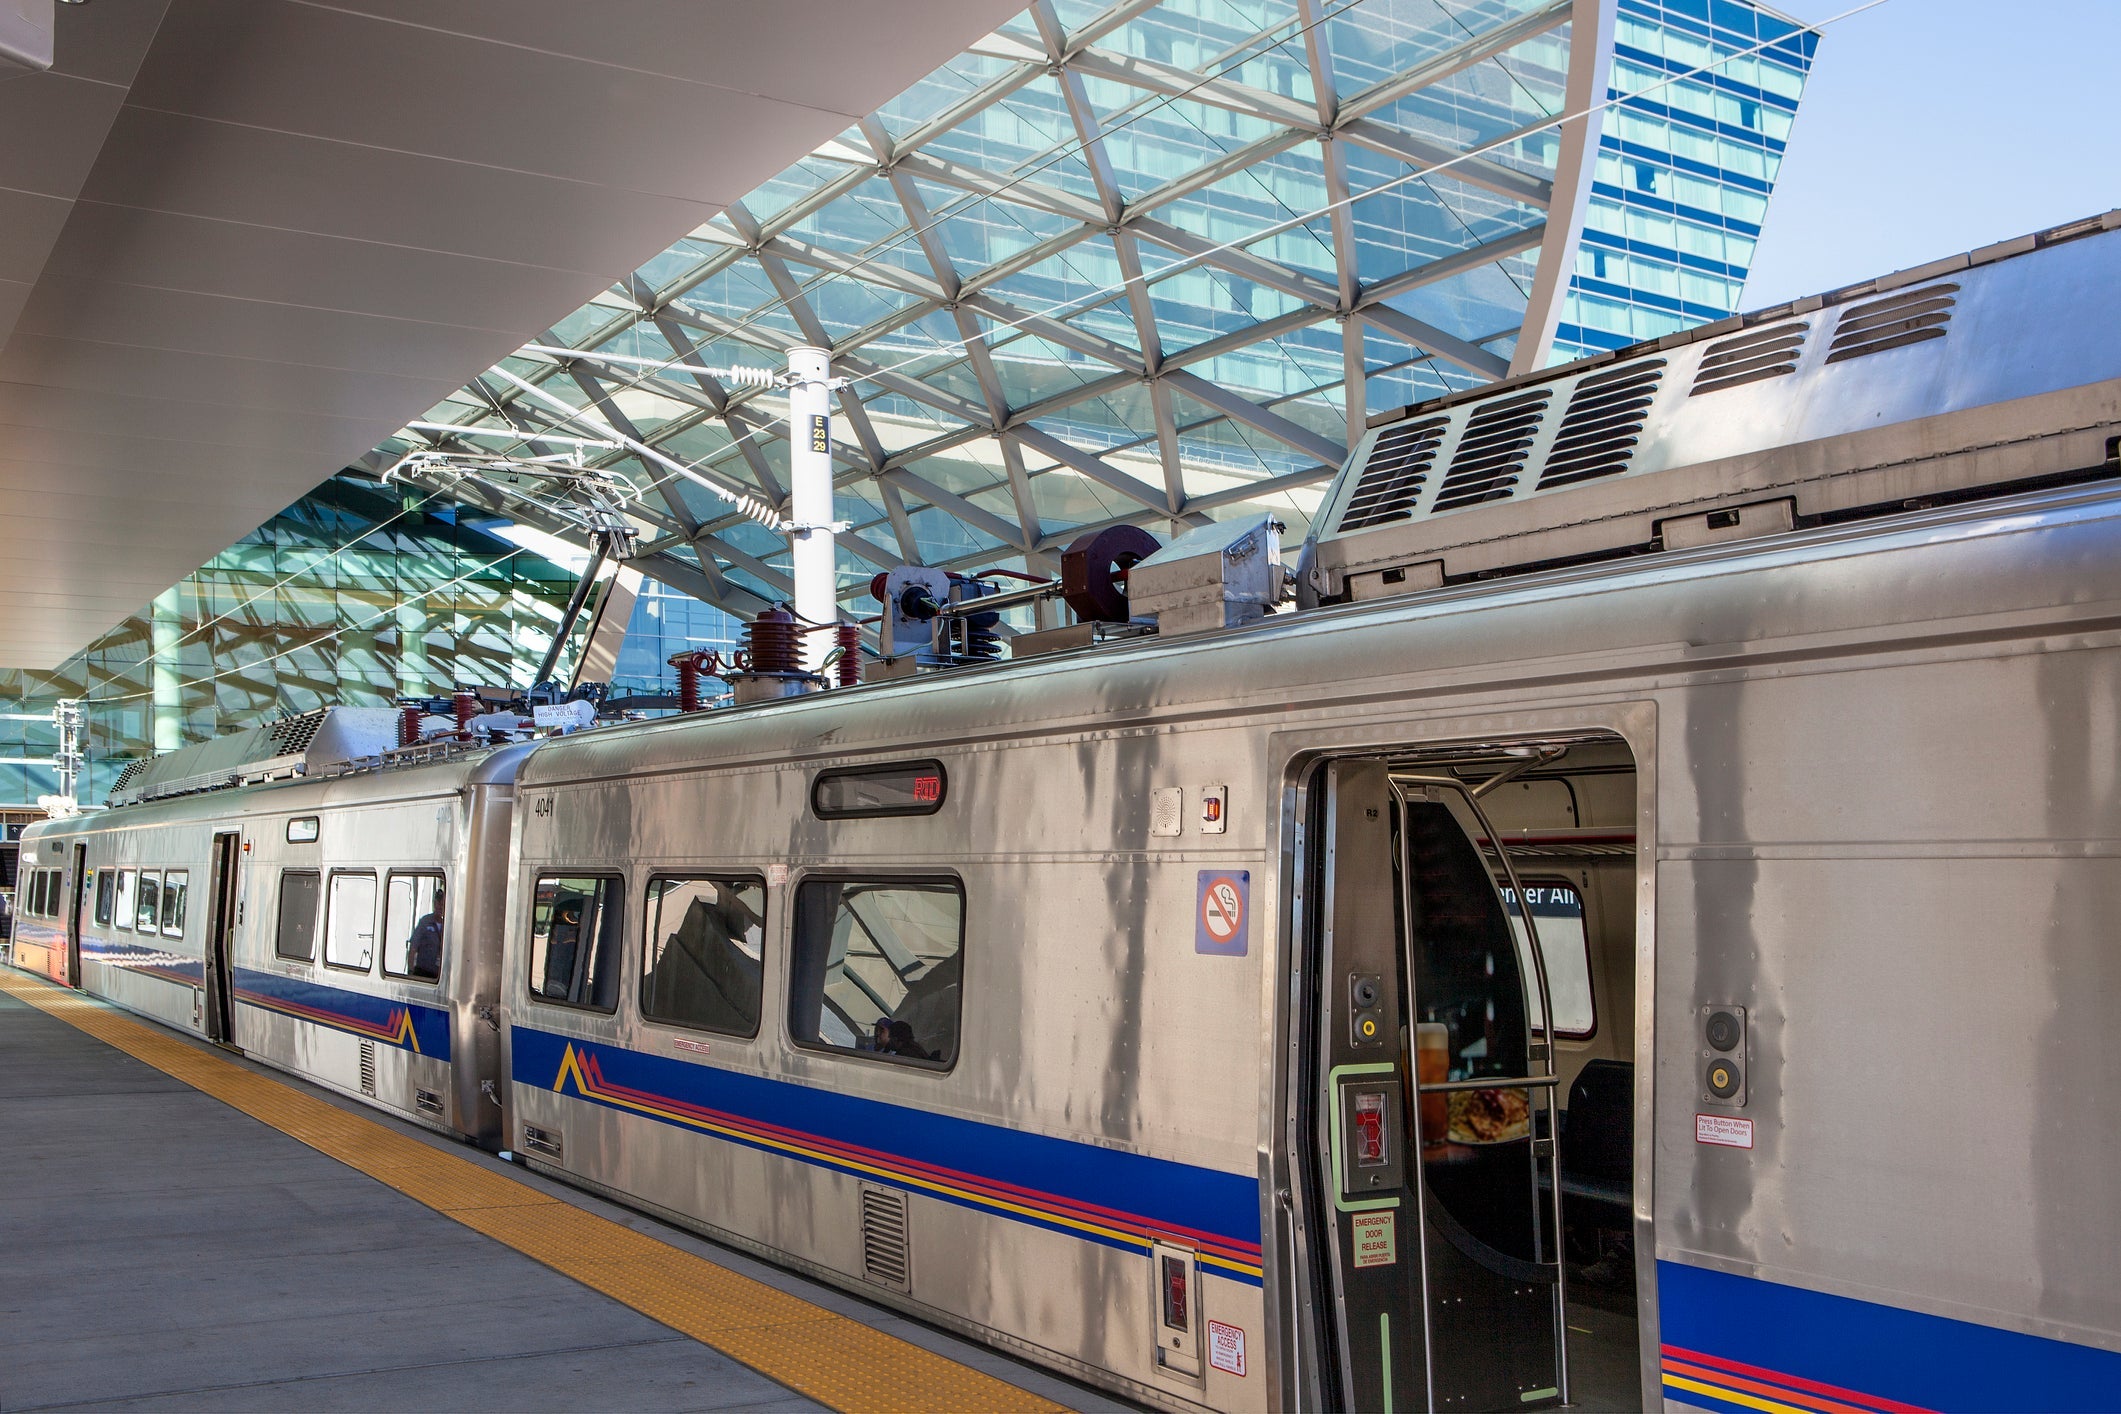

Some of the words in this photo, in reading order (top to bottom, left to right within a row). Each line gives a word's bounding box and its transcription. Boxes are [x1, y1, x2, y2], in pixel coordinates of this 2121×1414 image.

[815, 416, 823, 427] E
[813, 428, 826, 440] 23
[813, 440, 826, 452] 29
[547, 704, 571, 712] DANGER
[538, 711, 553, 719] HIGH
[555, 709, 583, 717] VOLTAGE
[913, 776, 941, 801] RTD
[535, 797, 555, 818] 4041
[1698, 1117, 1713, 1125] Press
[1713, 1119, 1733, 1127] Button
[1733, 1121, 1750, 1129] When
[1713, 1126, 1730, 1134] Open
[1730, 1128, 1748, 1136] Doors
[1355, 1216, 1391, 1227] EMERGENCY
[1365, 1230, 1383, 1238] DOOR
[1361, 1241, 1388, 1251] RELEASE
[1211, 1323, 1242, 1341] EMERGENCY
[1217, 1335, 1237, 1350] ACCESS
